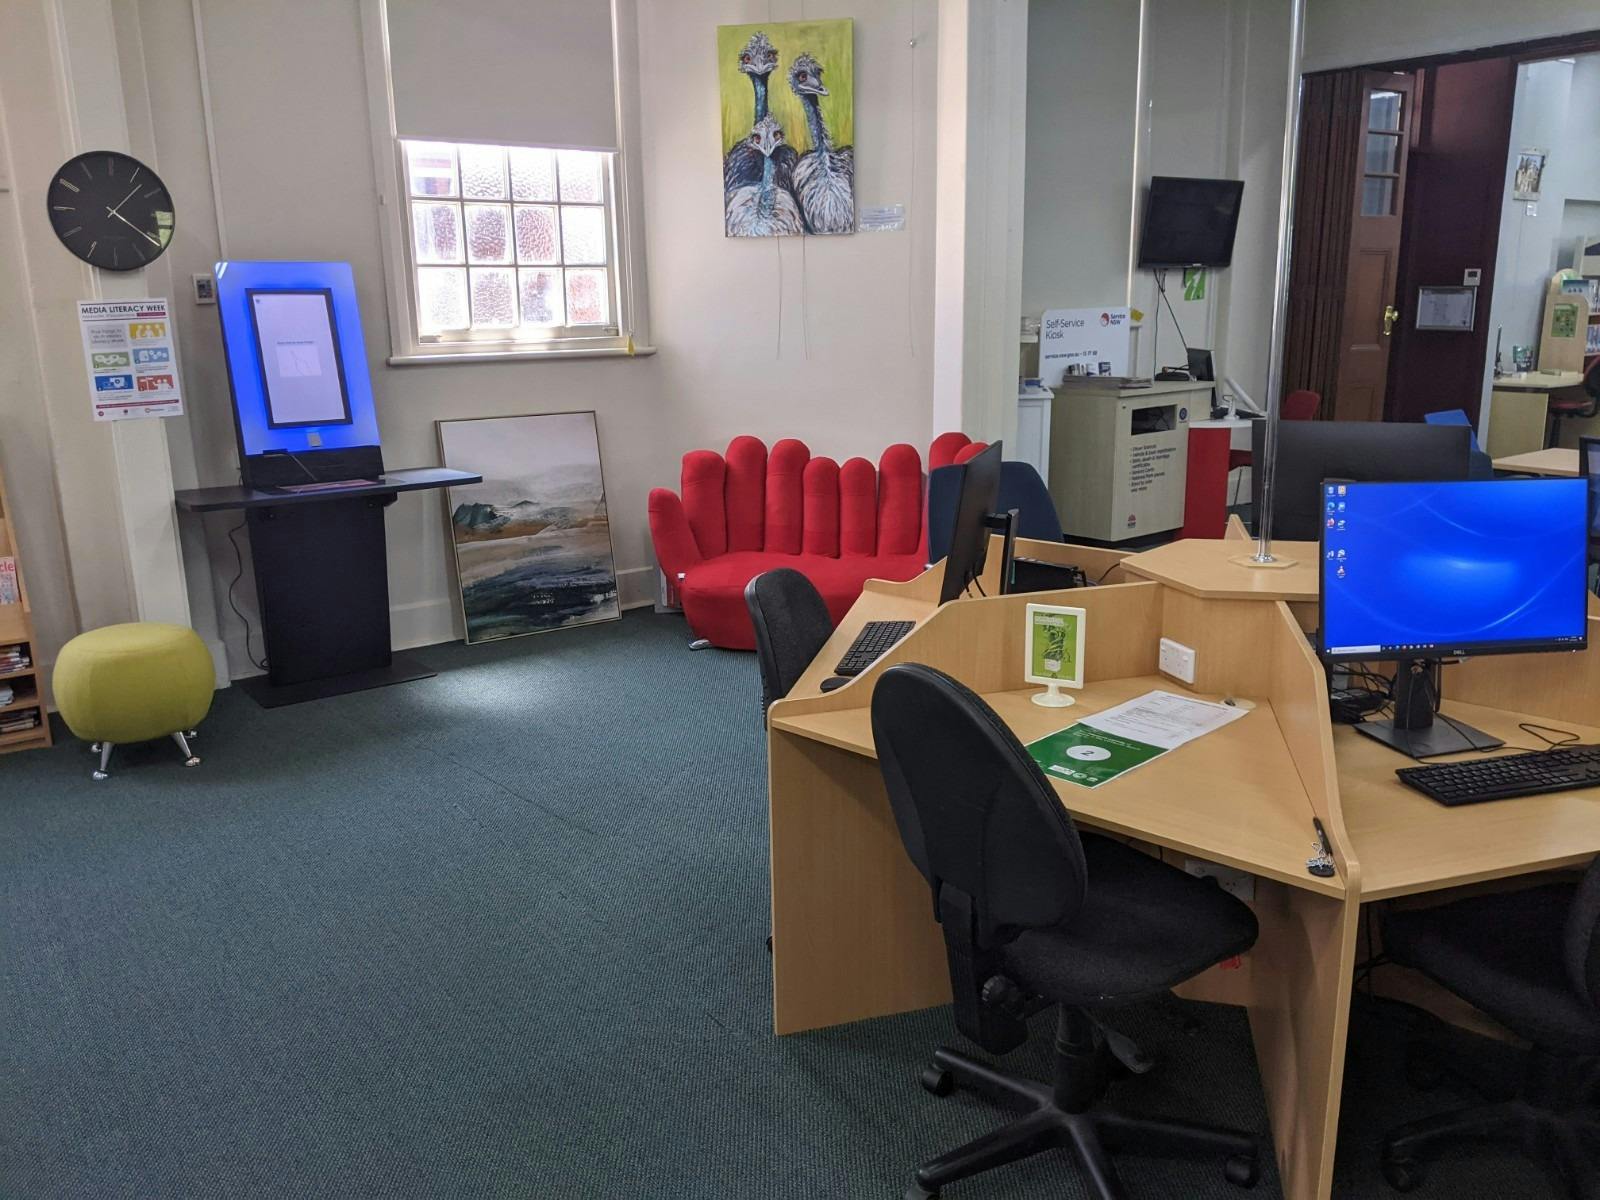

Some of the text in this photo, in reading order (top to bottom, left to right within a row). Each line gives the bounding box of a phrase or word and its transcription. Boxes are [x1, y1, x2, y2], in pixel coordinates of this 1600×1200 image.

[81, 304, 165, 314] MEDIA LITERACY WEEK
[1046, 319, 1085, 329] Self-Service
[1045, 330, 1064, 340] Kiosk
